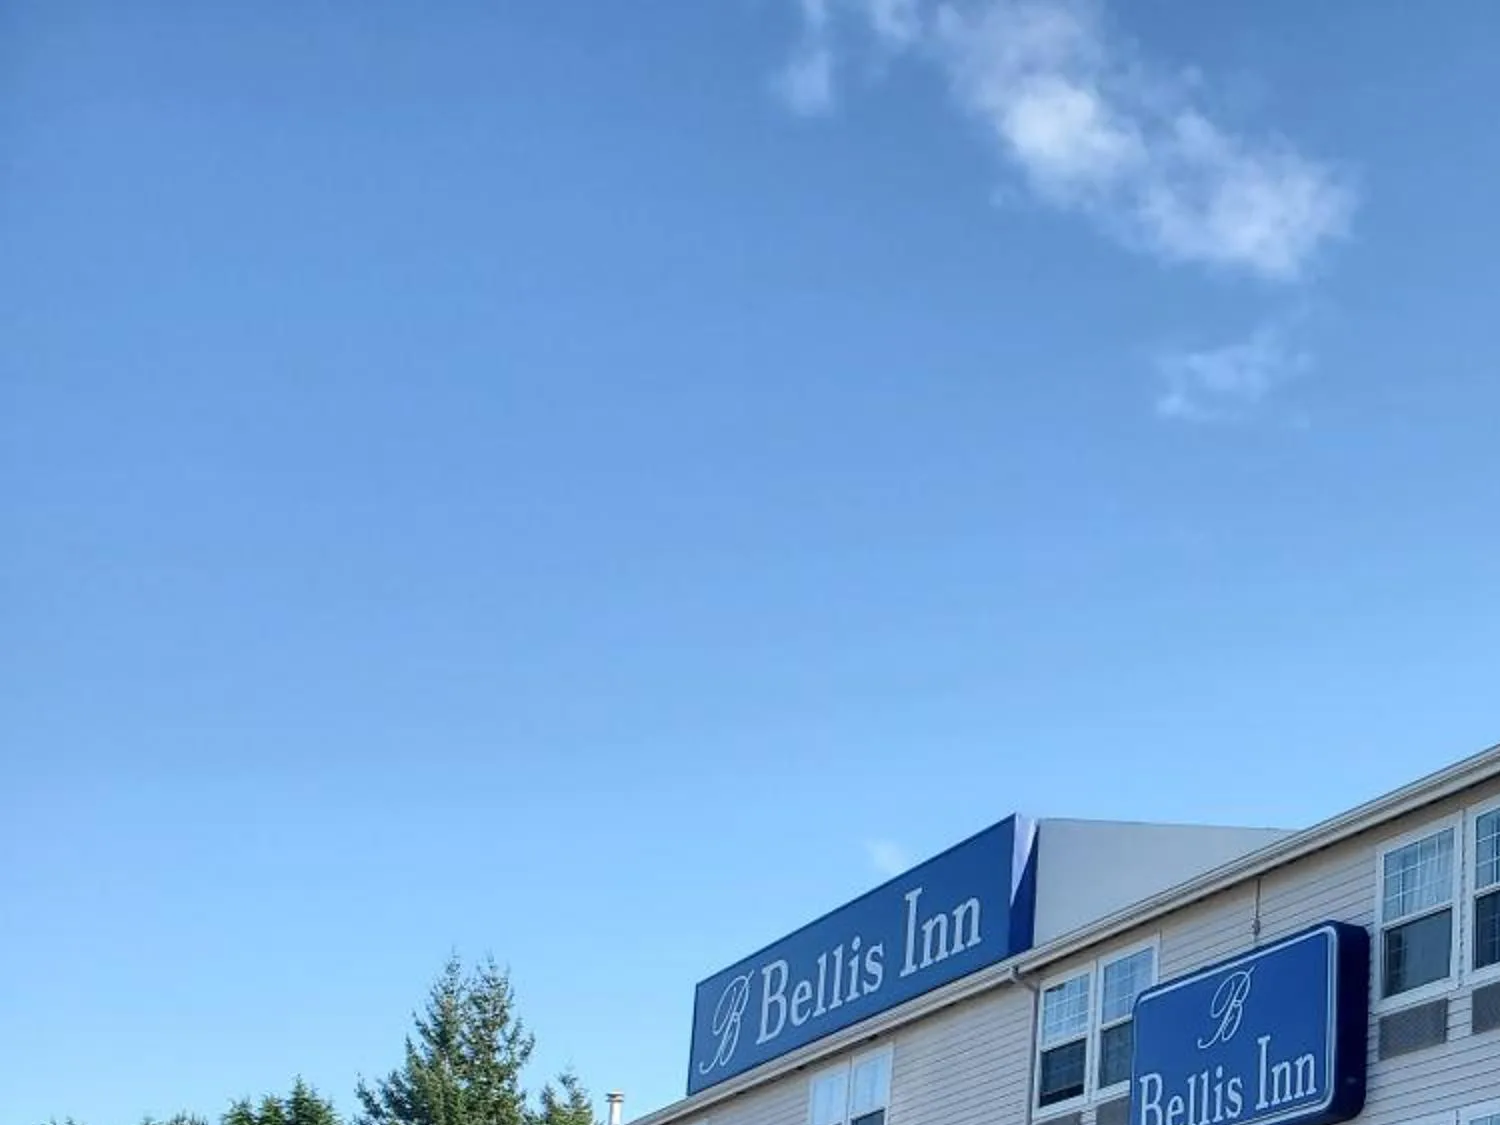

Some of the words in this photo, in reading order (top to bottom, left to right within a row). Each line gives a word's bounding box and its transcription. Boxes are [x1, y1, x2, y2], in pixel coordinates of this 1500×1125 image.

[755, 936, 884, 1045] Bellis
[900, 887, 982, 977] Inn
[1255, 1035, 1317, 1110] Inn
